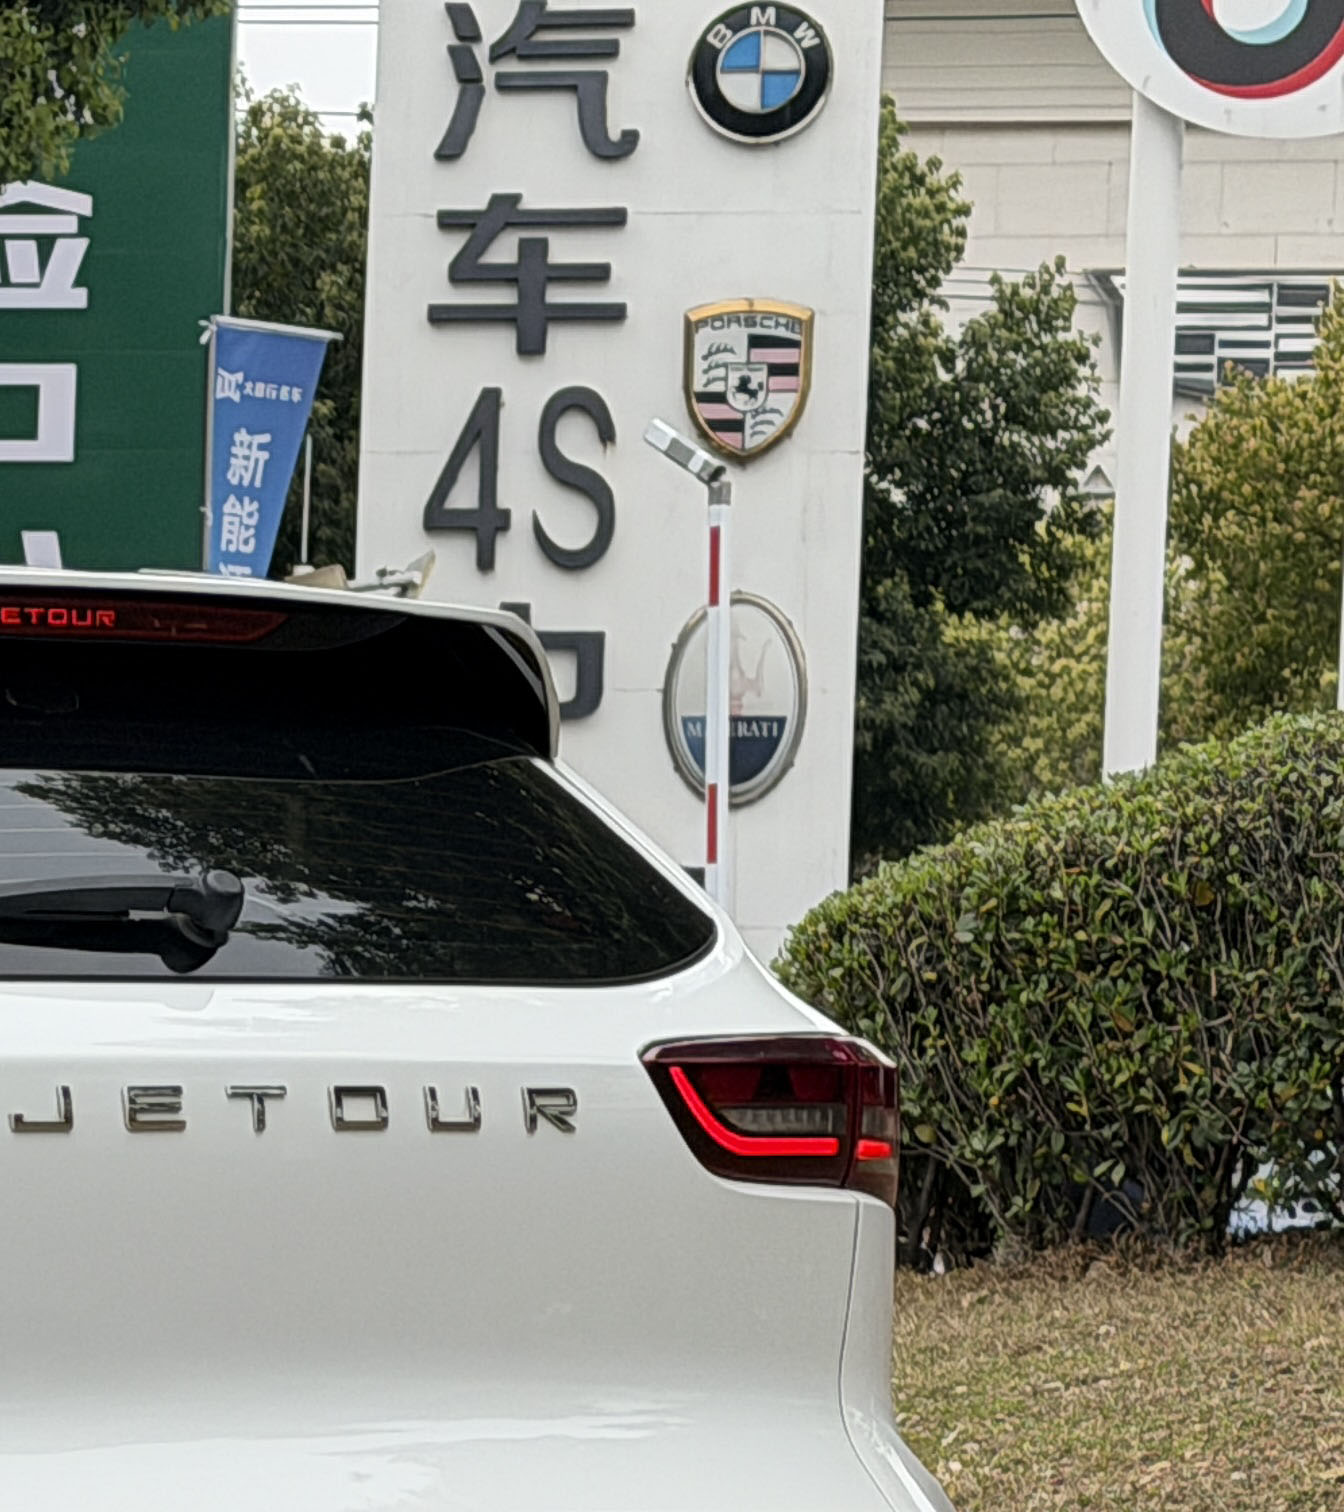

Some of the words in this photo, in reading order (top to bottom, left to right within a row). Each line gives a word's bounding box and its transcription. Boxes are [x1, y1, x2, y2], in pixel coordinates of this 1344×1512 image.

[706, 5, 822, 52] BMW
[686, 720, 779, 738] MRATI
[8, 1084, 580, 1133] JETOUR
